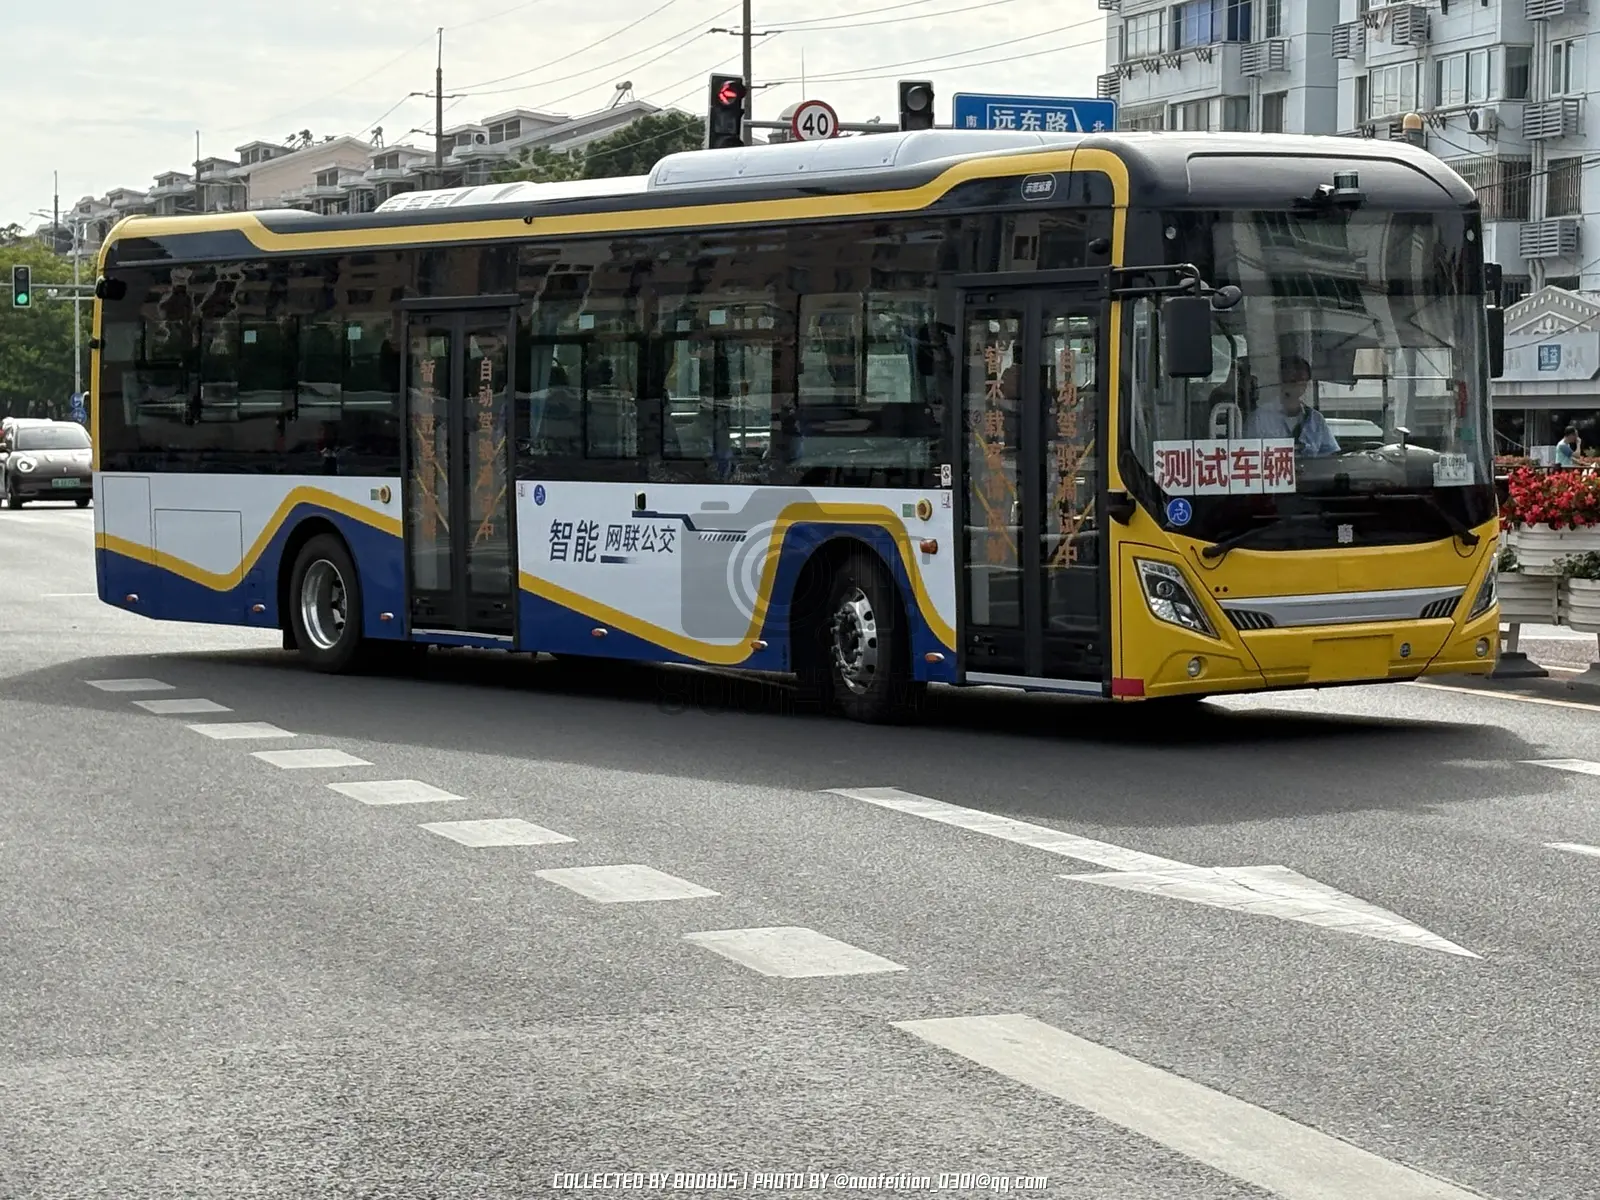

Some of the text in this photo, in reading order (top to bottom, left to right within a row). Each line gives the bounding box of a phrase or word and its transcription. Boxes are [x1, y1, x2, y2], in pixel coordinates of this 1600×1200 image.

[802, 113, 828, 136] 40
[966, 109, 1105, 132] 南 远东路 北
[1156, 446, 1294, 488] 测试车辆
[549, 519, 676, 562] 智能 网联公交
